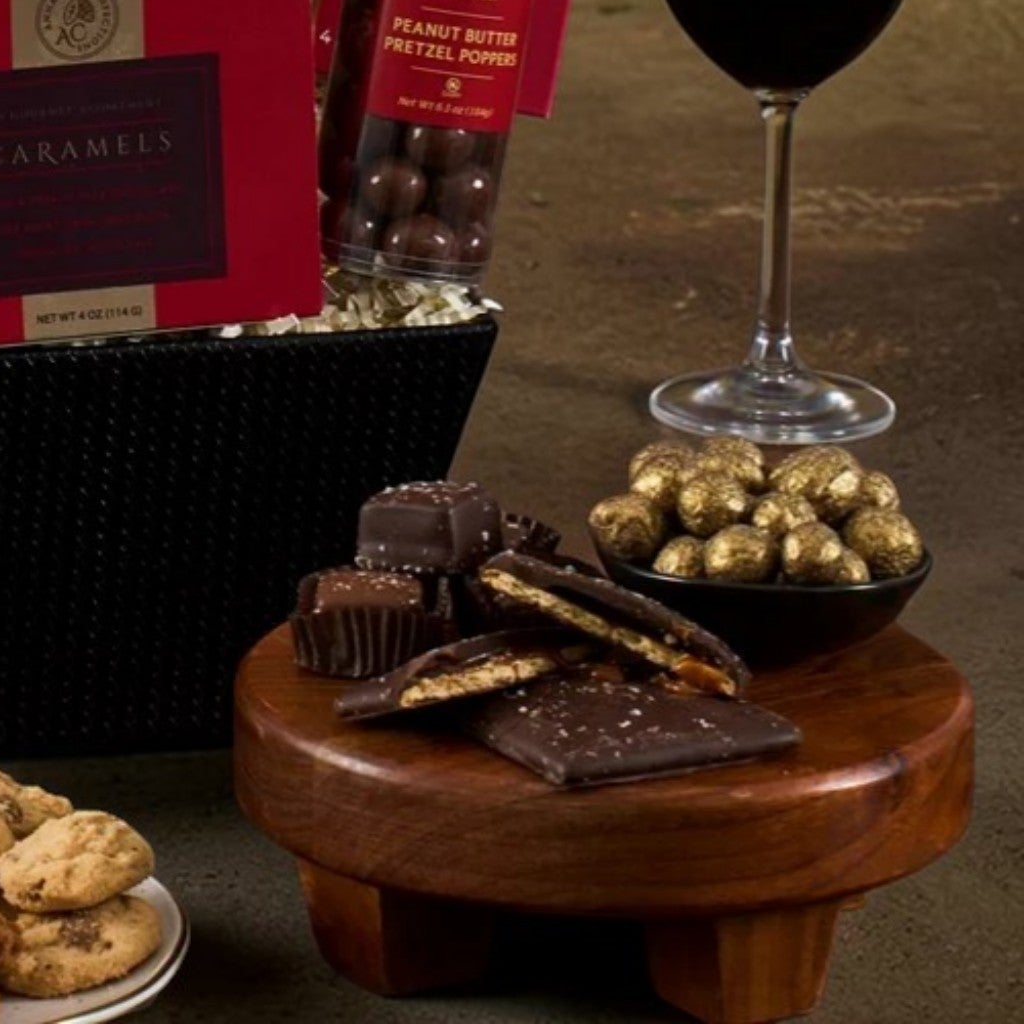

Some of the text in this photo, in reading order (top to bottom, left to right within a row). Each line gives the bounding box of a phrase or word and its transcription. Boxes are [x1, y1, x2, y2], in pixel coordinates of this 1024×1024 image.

[393, 17, 518, 47] PEANUT BUTTER
[383, 35, 517, 67] PRETZEL POPPERS
[36, 311, 57, 324] NET
[59, 311, 76, 323] WT
[78, 310, 87, 321] 4
[88, 309, 104, 321] OZ
[105, 307, 128, 322] (114
